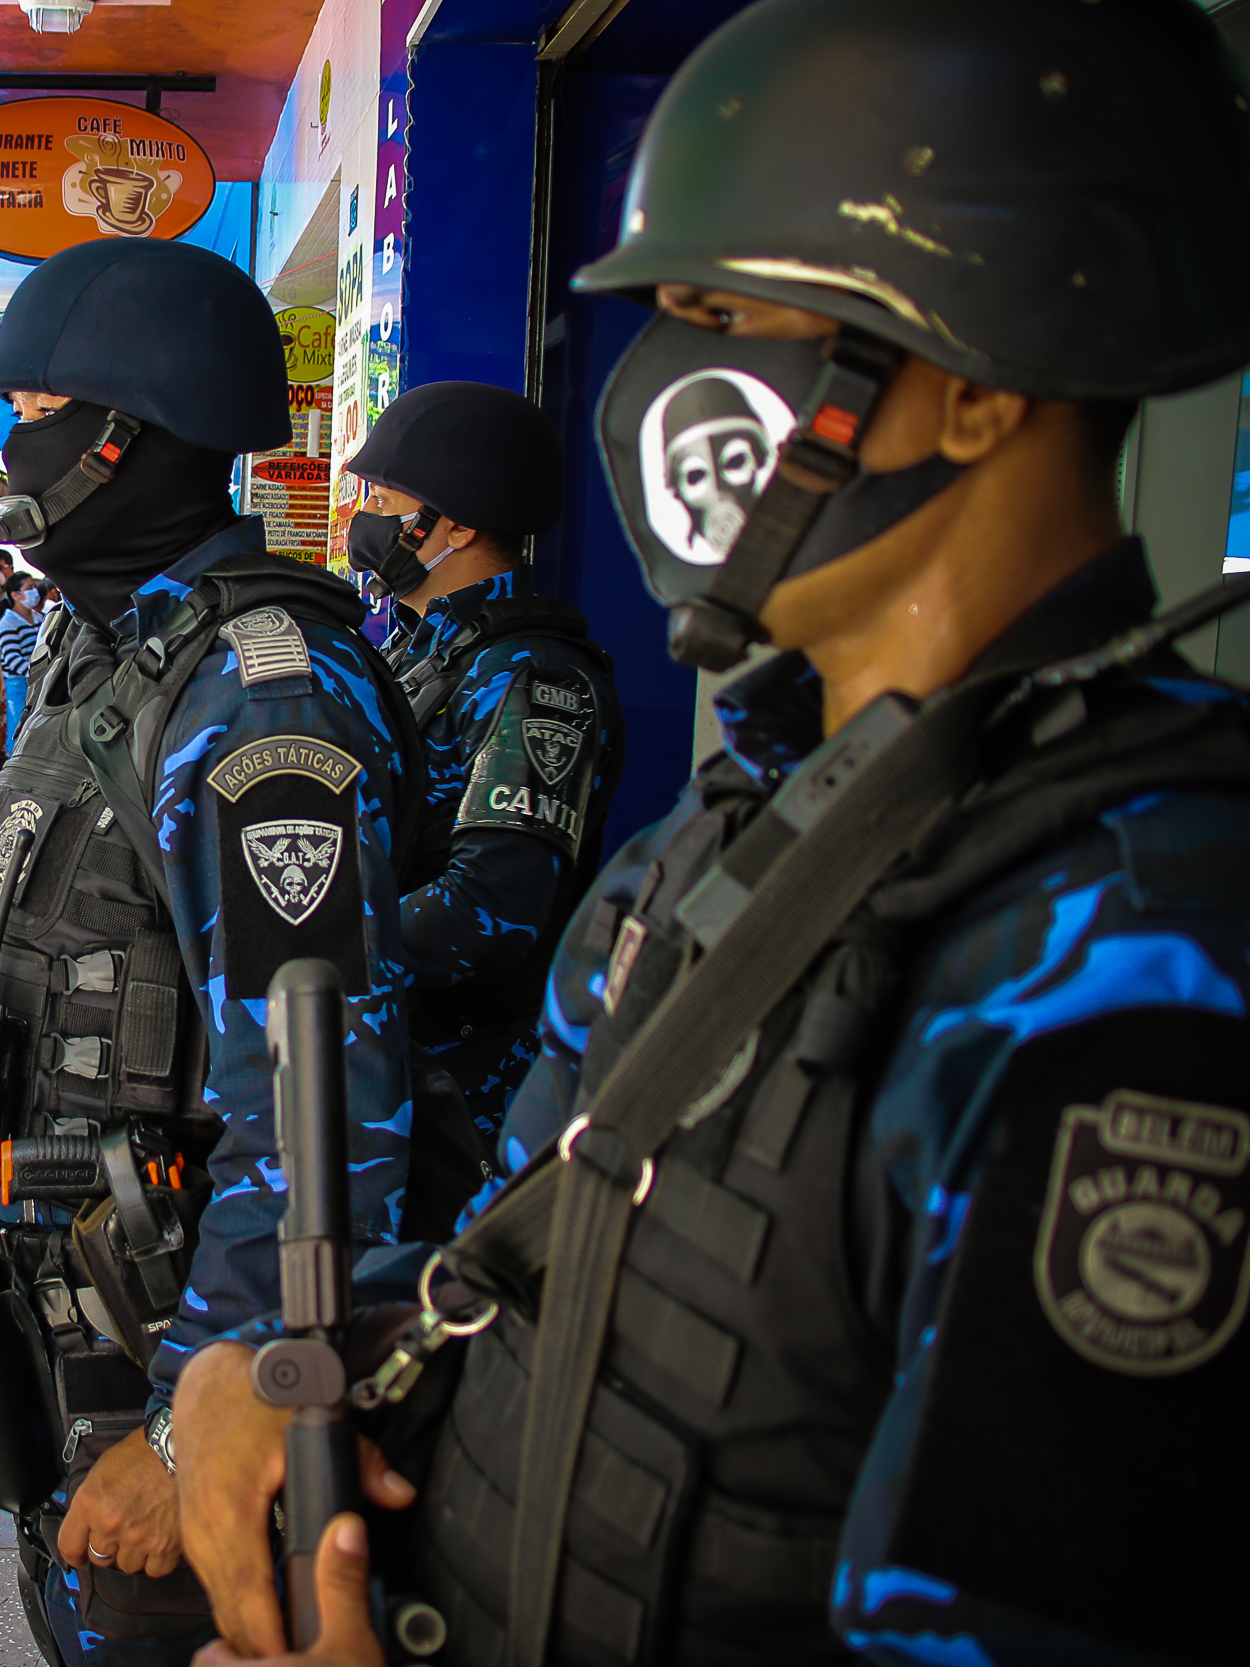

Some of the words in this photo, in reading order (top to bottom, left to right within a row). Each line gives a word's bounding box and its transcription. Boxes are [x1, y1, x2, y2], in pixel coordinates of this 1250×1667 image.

[77, 115, 123, 135] CAFÉ
[127, 138, 187, 162] MIXTO
[338, 243, 363, 326] SOPA
[303, 349, 334, 366] Mixt
[267, 471, 330, 481] VARIADAS
[268, 461, 330, 473] REFEIÇÕES
[304, 550, 314, 560] DE
[535, 686, 578, 710] GMB
[525, 727, 578, 747] ATAC
[223, 750, 273, 791] AÇÕES
[277, 743, 345, 780] TÁTICAS
[37, 1169, 95, 1179] CONDOR
[1067, 1165, 1245, 1248] GUARDA
[147, 1318, 172, 1332] SPA
